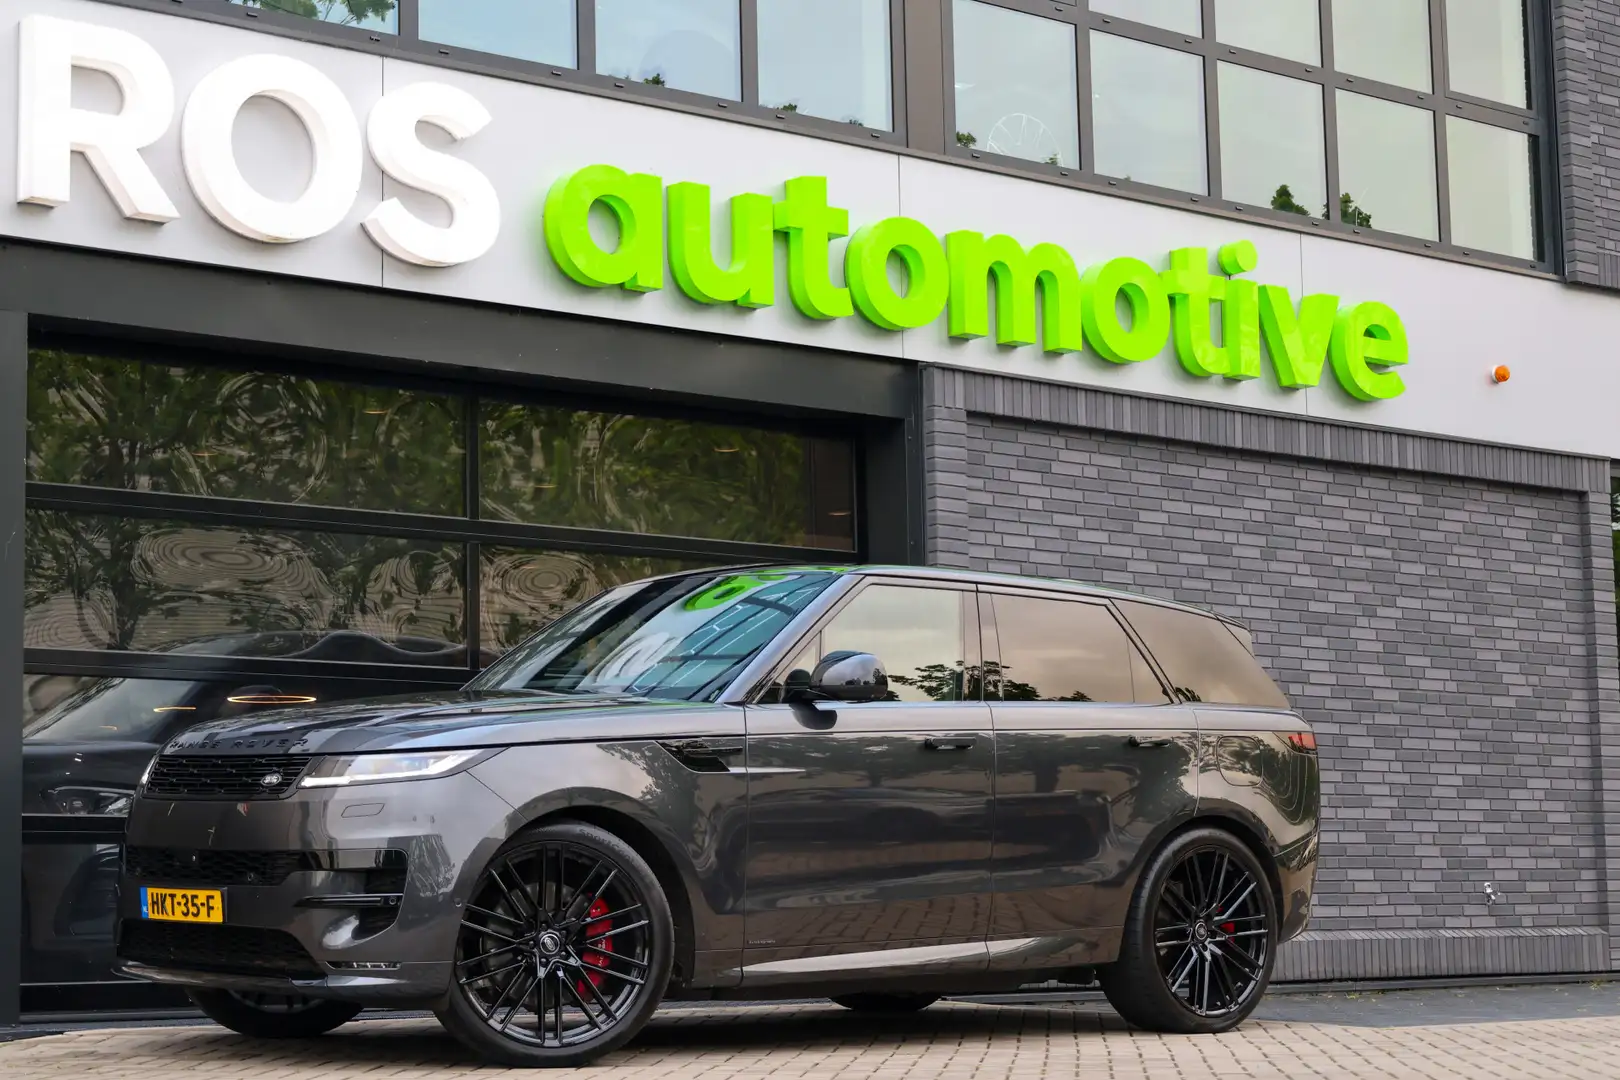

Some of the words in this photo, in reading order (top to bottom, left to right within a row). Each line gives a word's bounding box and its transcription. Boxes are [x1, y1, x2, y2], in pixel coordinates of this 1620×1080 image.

[17, 14, 501, 268] ROS
[544, 164, 1409, 400] automotive
[150, 891, 215, 918] HKT-35-F
